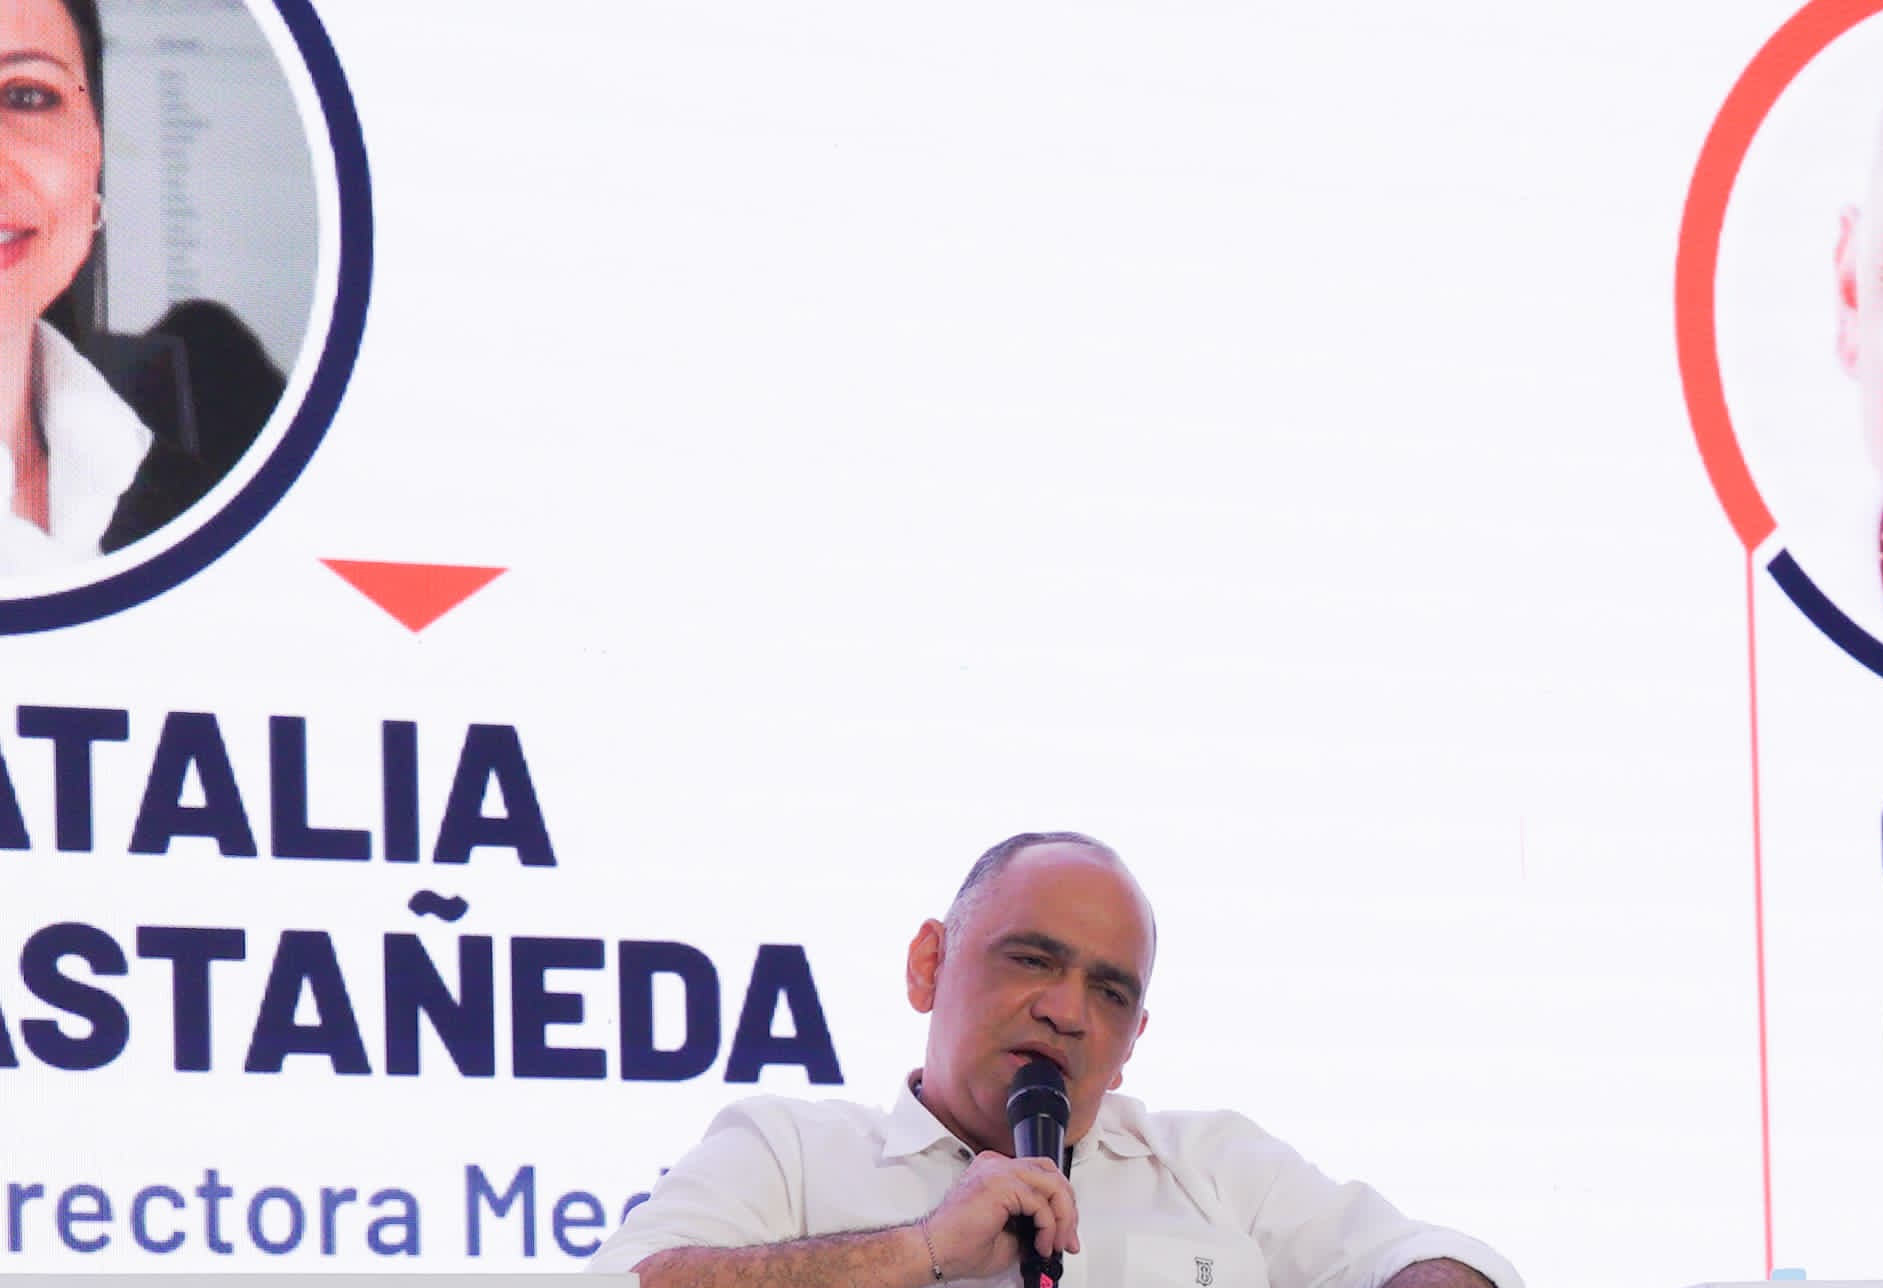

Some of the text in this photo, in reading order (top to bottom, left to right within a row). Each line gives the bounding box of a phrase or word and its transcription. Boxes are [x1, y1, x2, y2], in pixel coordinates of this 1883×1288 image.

[0, 704, 558, 868] TALIA
[0, 889, 845, 1086] STAÑEDA
[465, 1164, 669, 1258] Me
